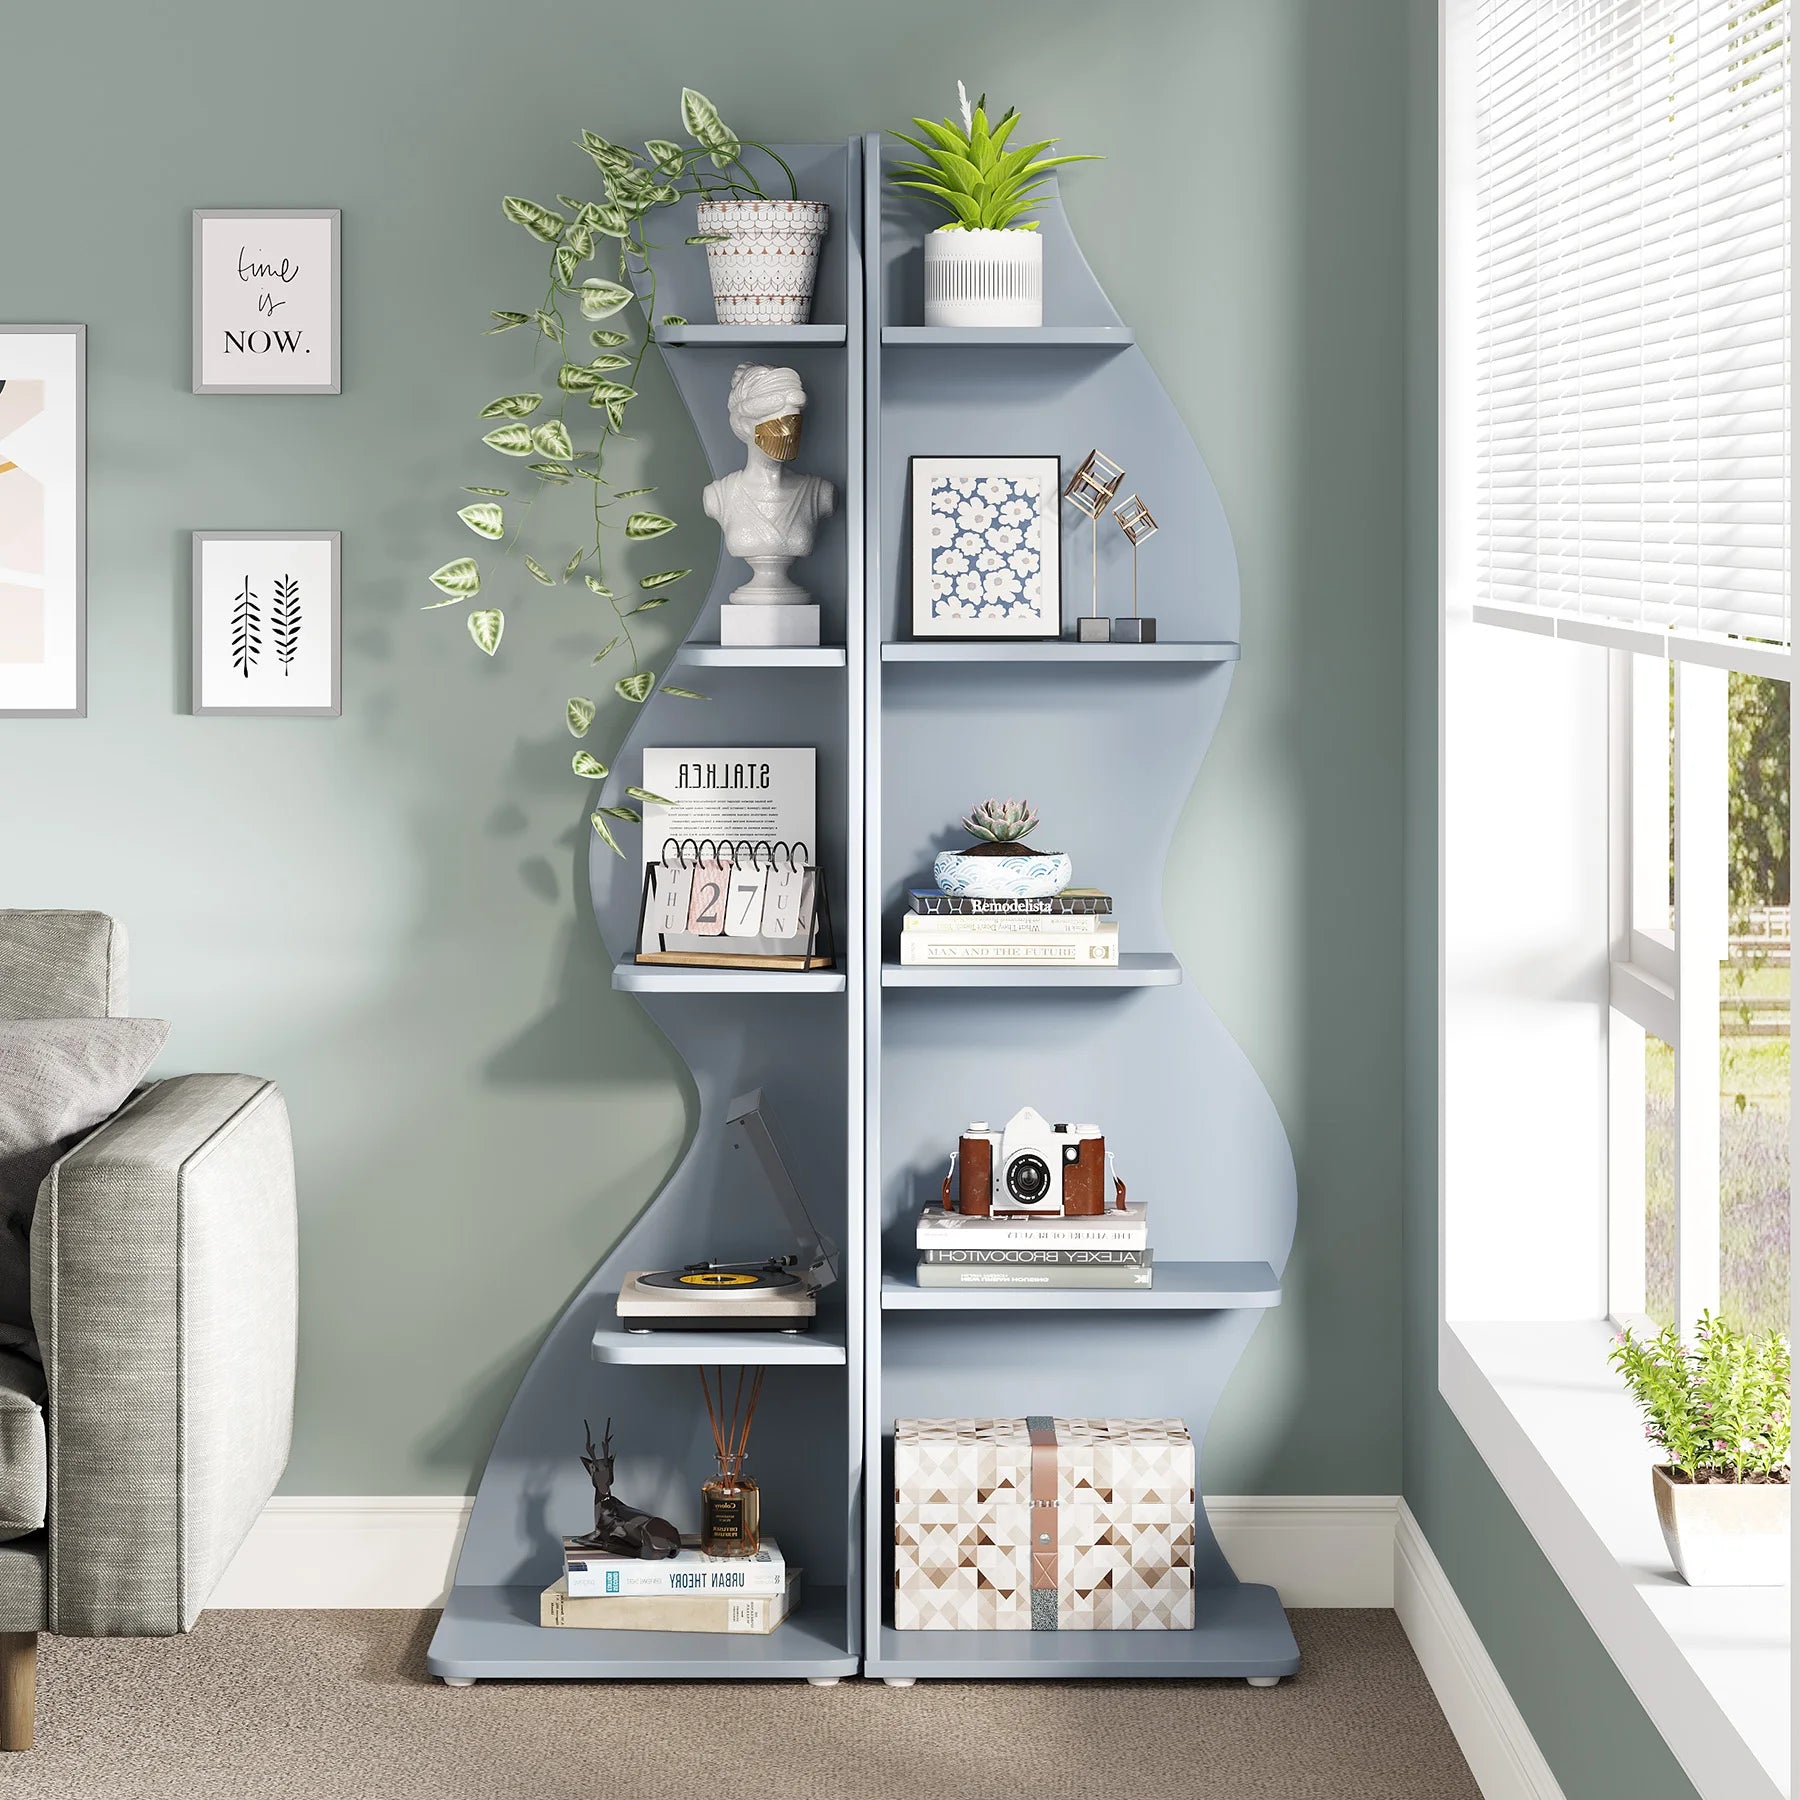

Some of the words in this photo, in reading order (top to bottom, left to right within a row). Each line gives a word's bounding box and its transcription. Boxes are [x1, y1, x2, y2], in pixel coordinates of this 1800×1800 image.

[237, 246, 299, 282] time
[258, 287, 286, 316] is
[223, 330, 310, 354] NOW.
[972, 898, 1052, 912] Remodelista
[928, 948, 957, 956] MAN
[961, 948, 989, 956] AND
[993, 948, 1021, 956] THE
[1025, 948, 1076, 956] FUTURE
